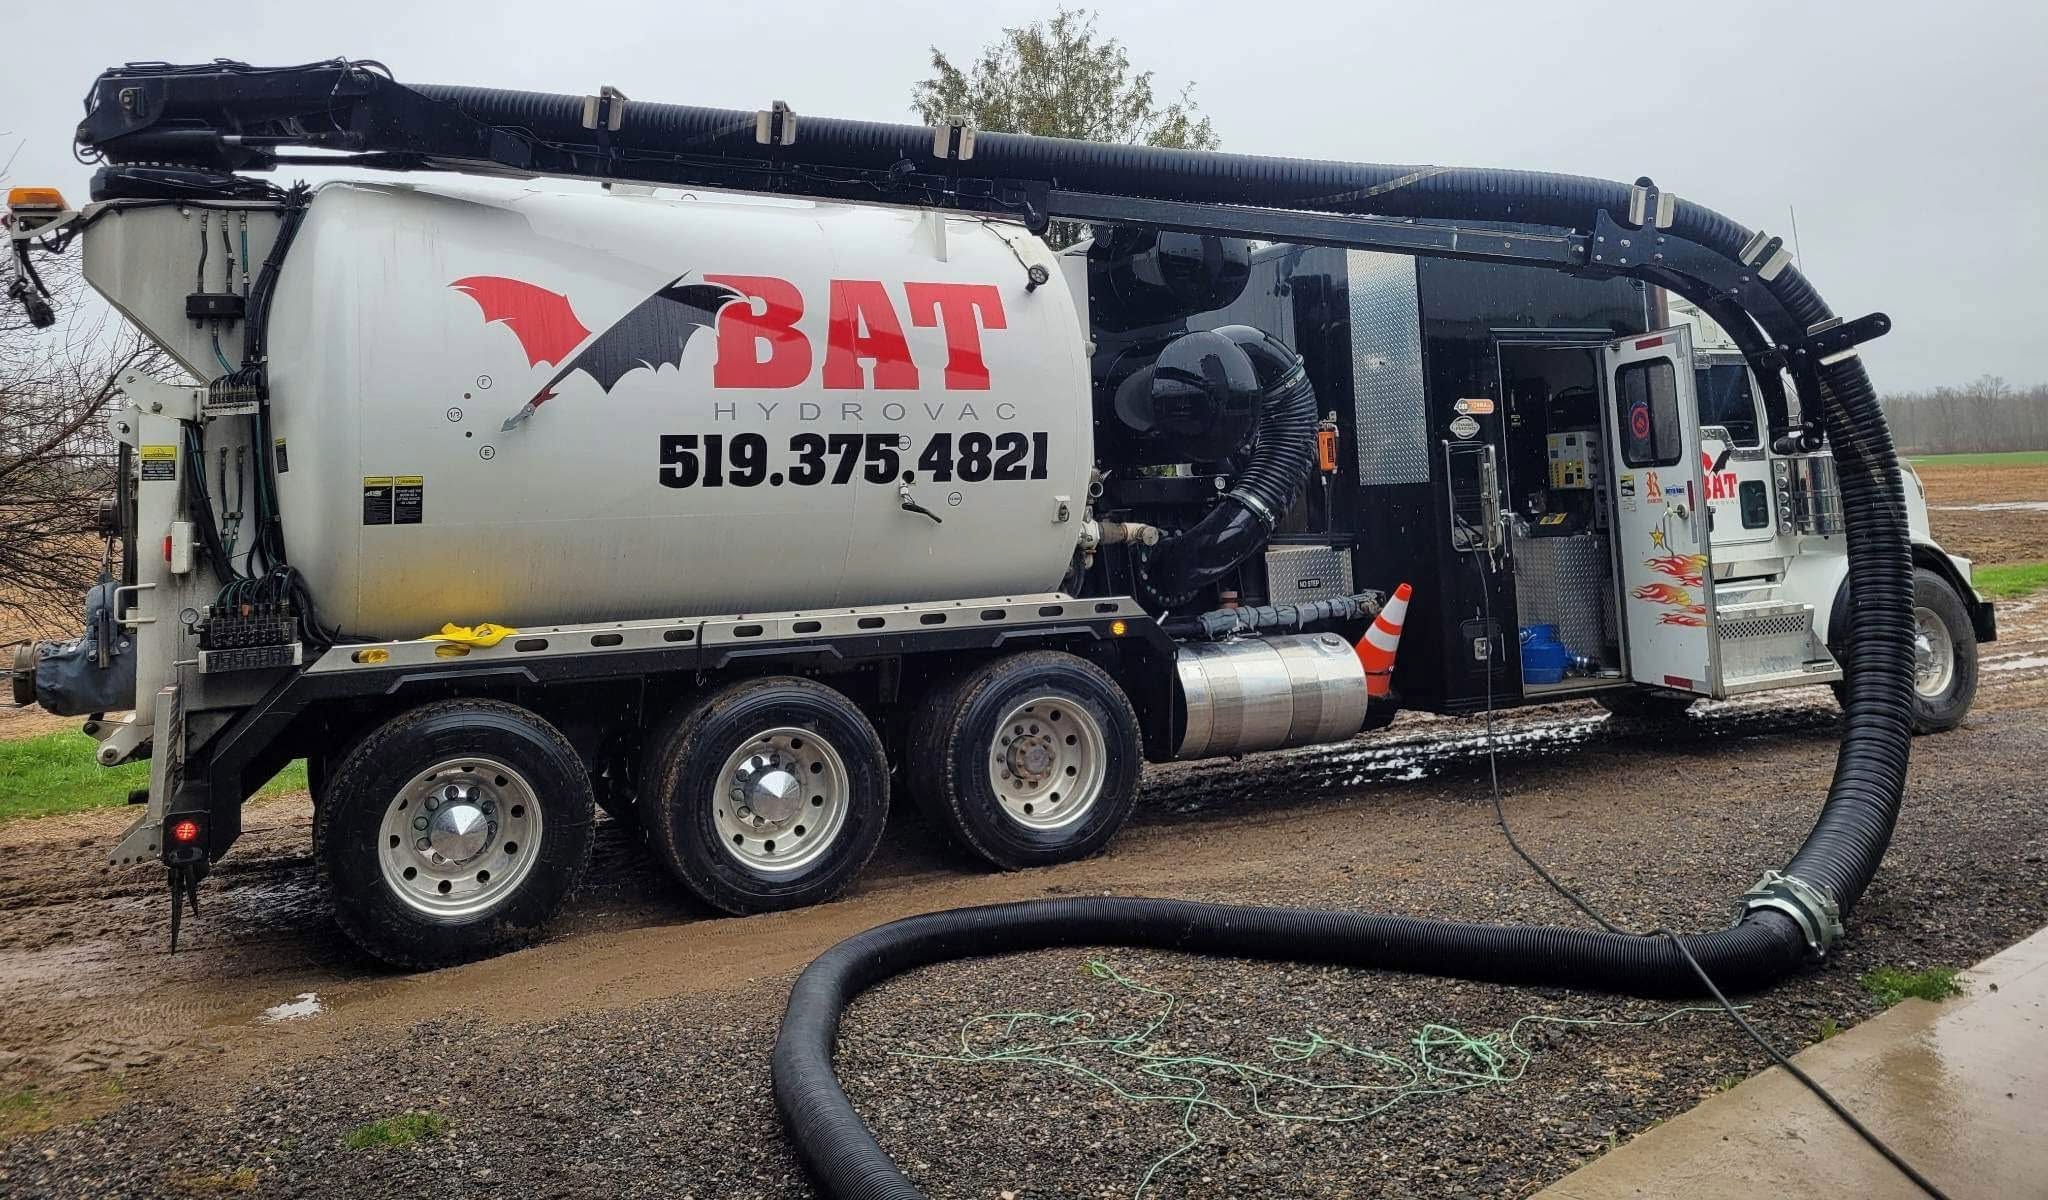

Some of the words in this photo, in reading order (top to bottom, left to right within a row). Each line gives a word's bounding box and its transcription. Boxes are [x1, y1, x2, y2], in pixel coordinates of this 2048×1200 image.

[702, 273, 1008, 390] BAT
[713, 402, 1017, 421] HYDROVAC
[658, 430, 1049, 489] 519.375.4821
[1703, 473, 1738, 500] BAT
[1300, 580, 1307, 588] NO
[1307, 579, 1320, 587] STEP
